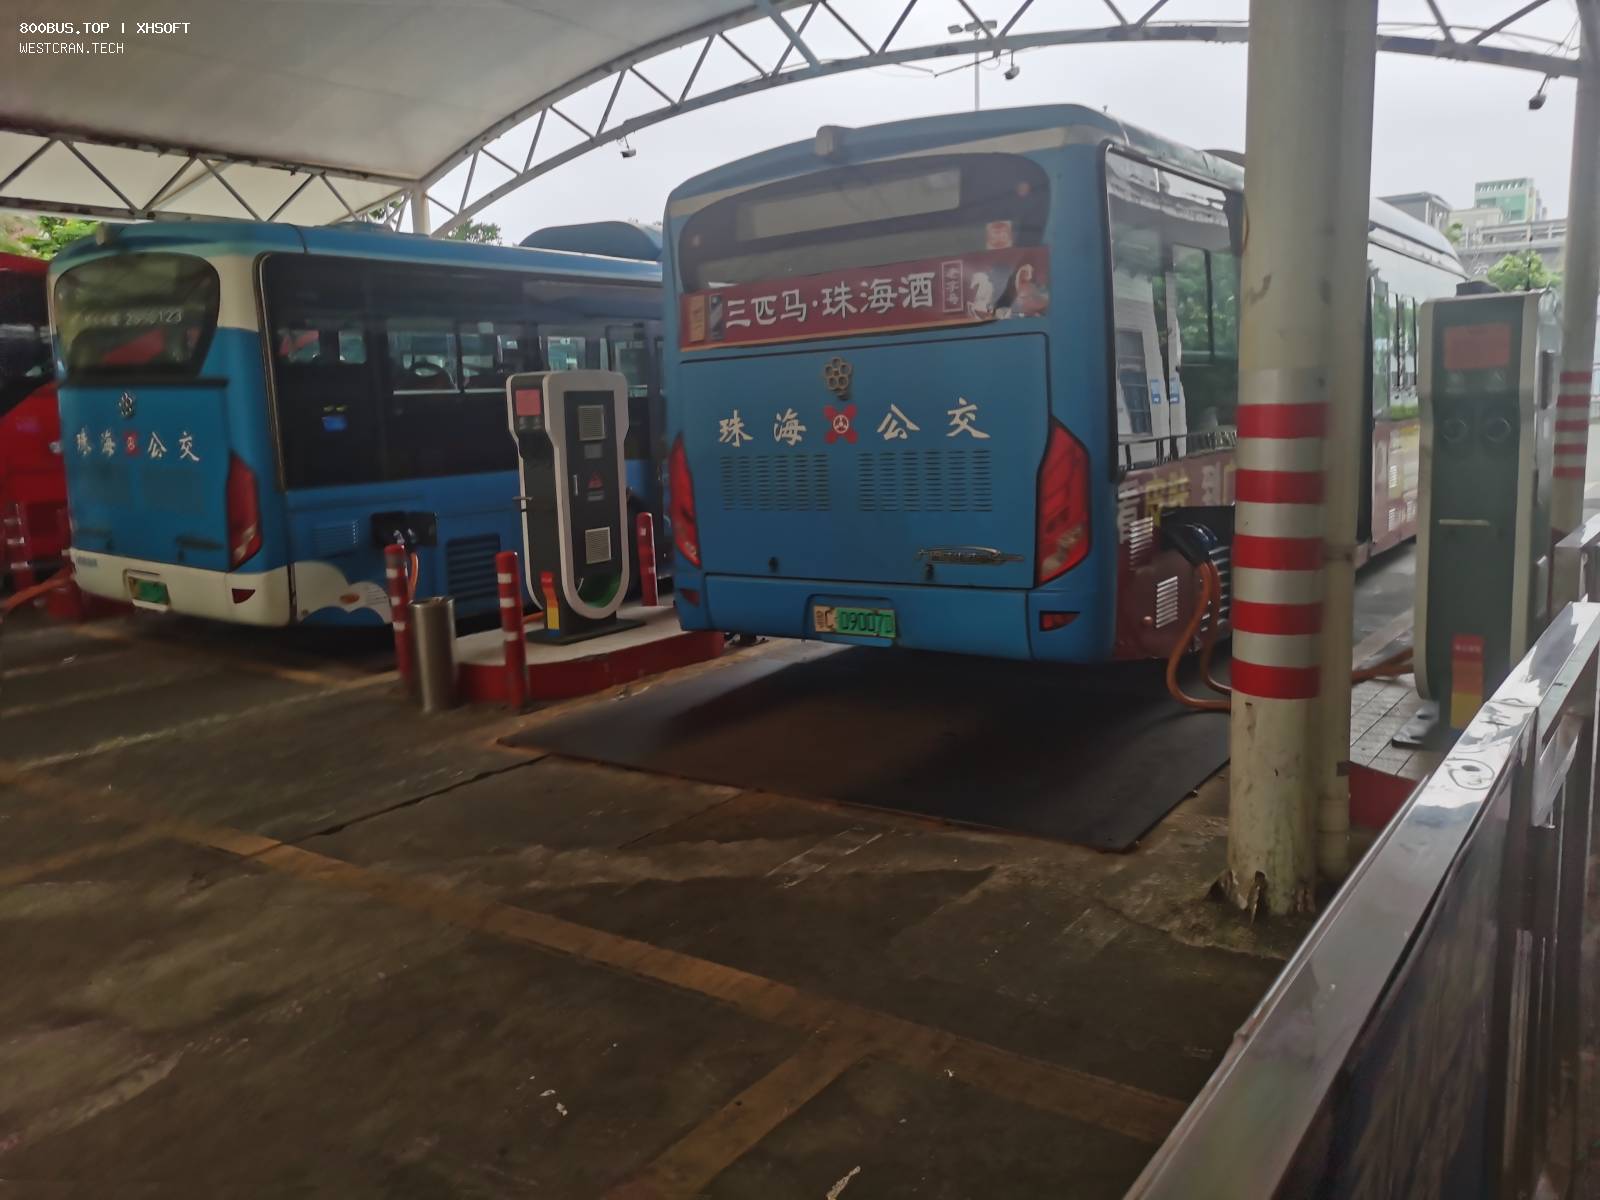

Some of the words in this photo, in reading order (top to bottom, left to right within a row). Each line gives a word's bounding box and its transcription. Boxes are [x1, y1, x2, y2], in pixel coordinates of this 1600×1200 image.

[726, 272, 936, 329] 三匹马·珠海酒
